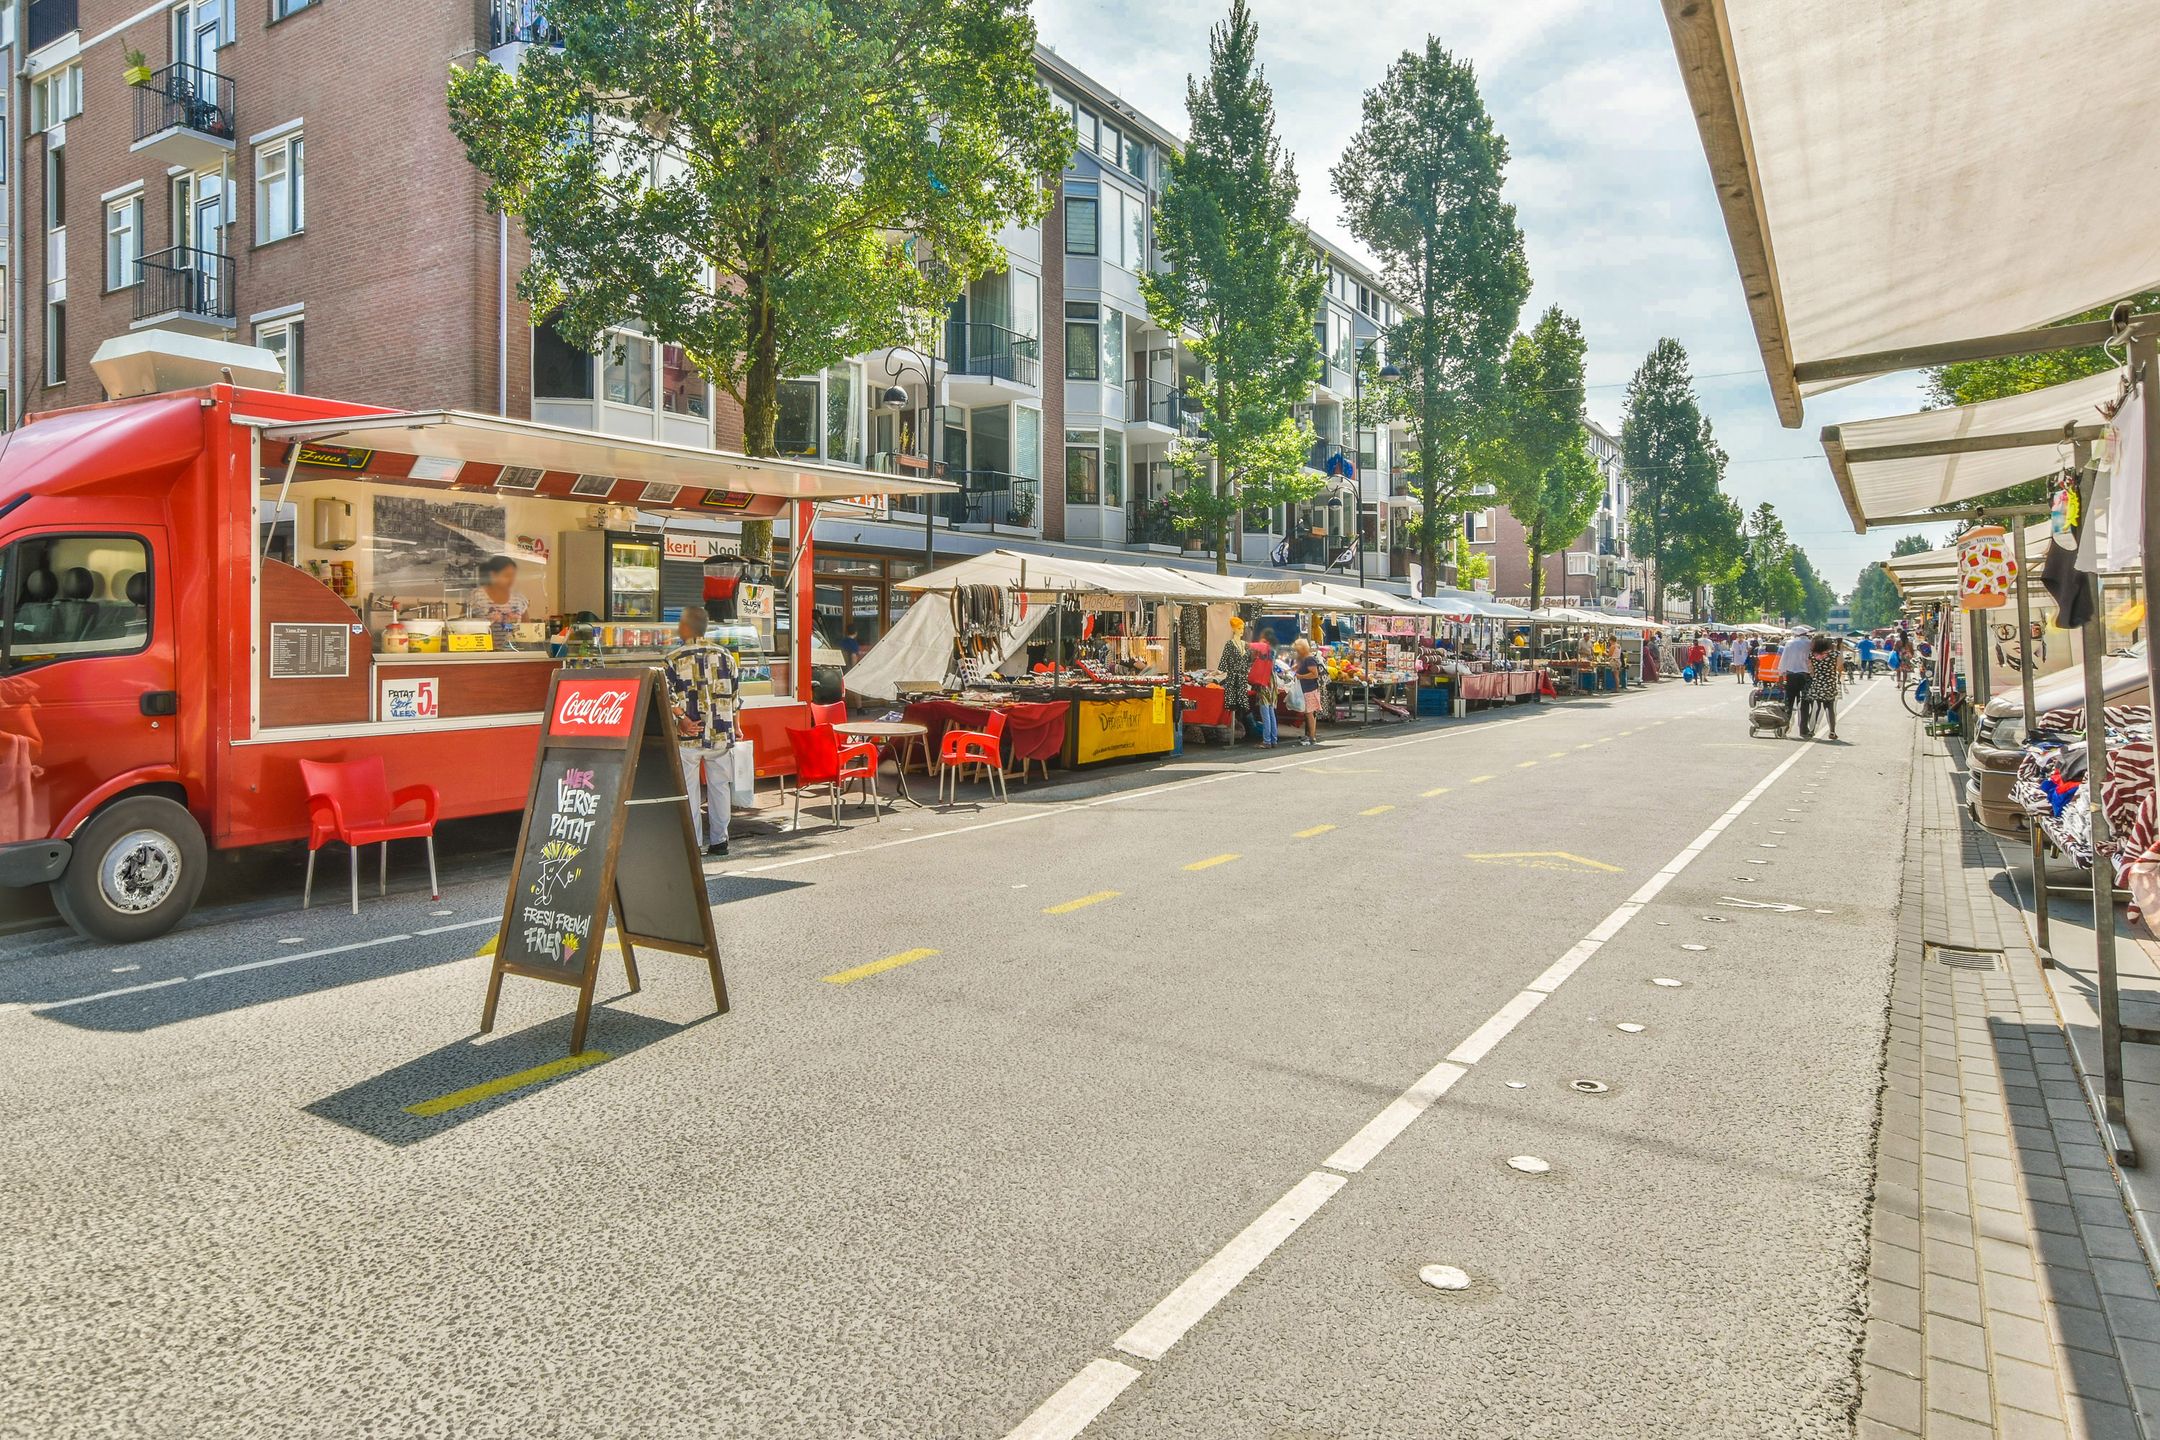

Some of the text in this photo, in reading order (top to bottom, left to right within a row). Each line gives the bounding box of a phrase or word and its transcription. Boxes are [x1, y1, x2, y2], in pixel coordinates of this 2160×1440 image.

[298, 449, 342, 462] Frites
[663, 537, 697, 558] kerij
[388, 689, 416, 698] PATAT
[559, 691, 631, 725] Coca-Cola
[557, 778, 601, 817] VERSE
[549, 813, 596, 845] PATAT
[523, 905, 591, 938] FRESH FRENCH
[524, 927, 562, 962] FRIES
